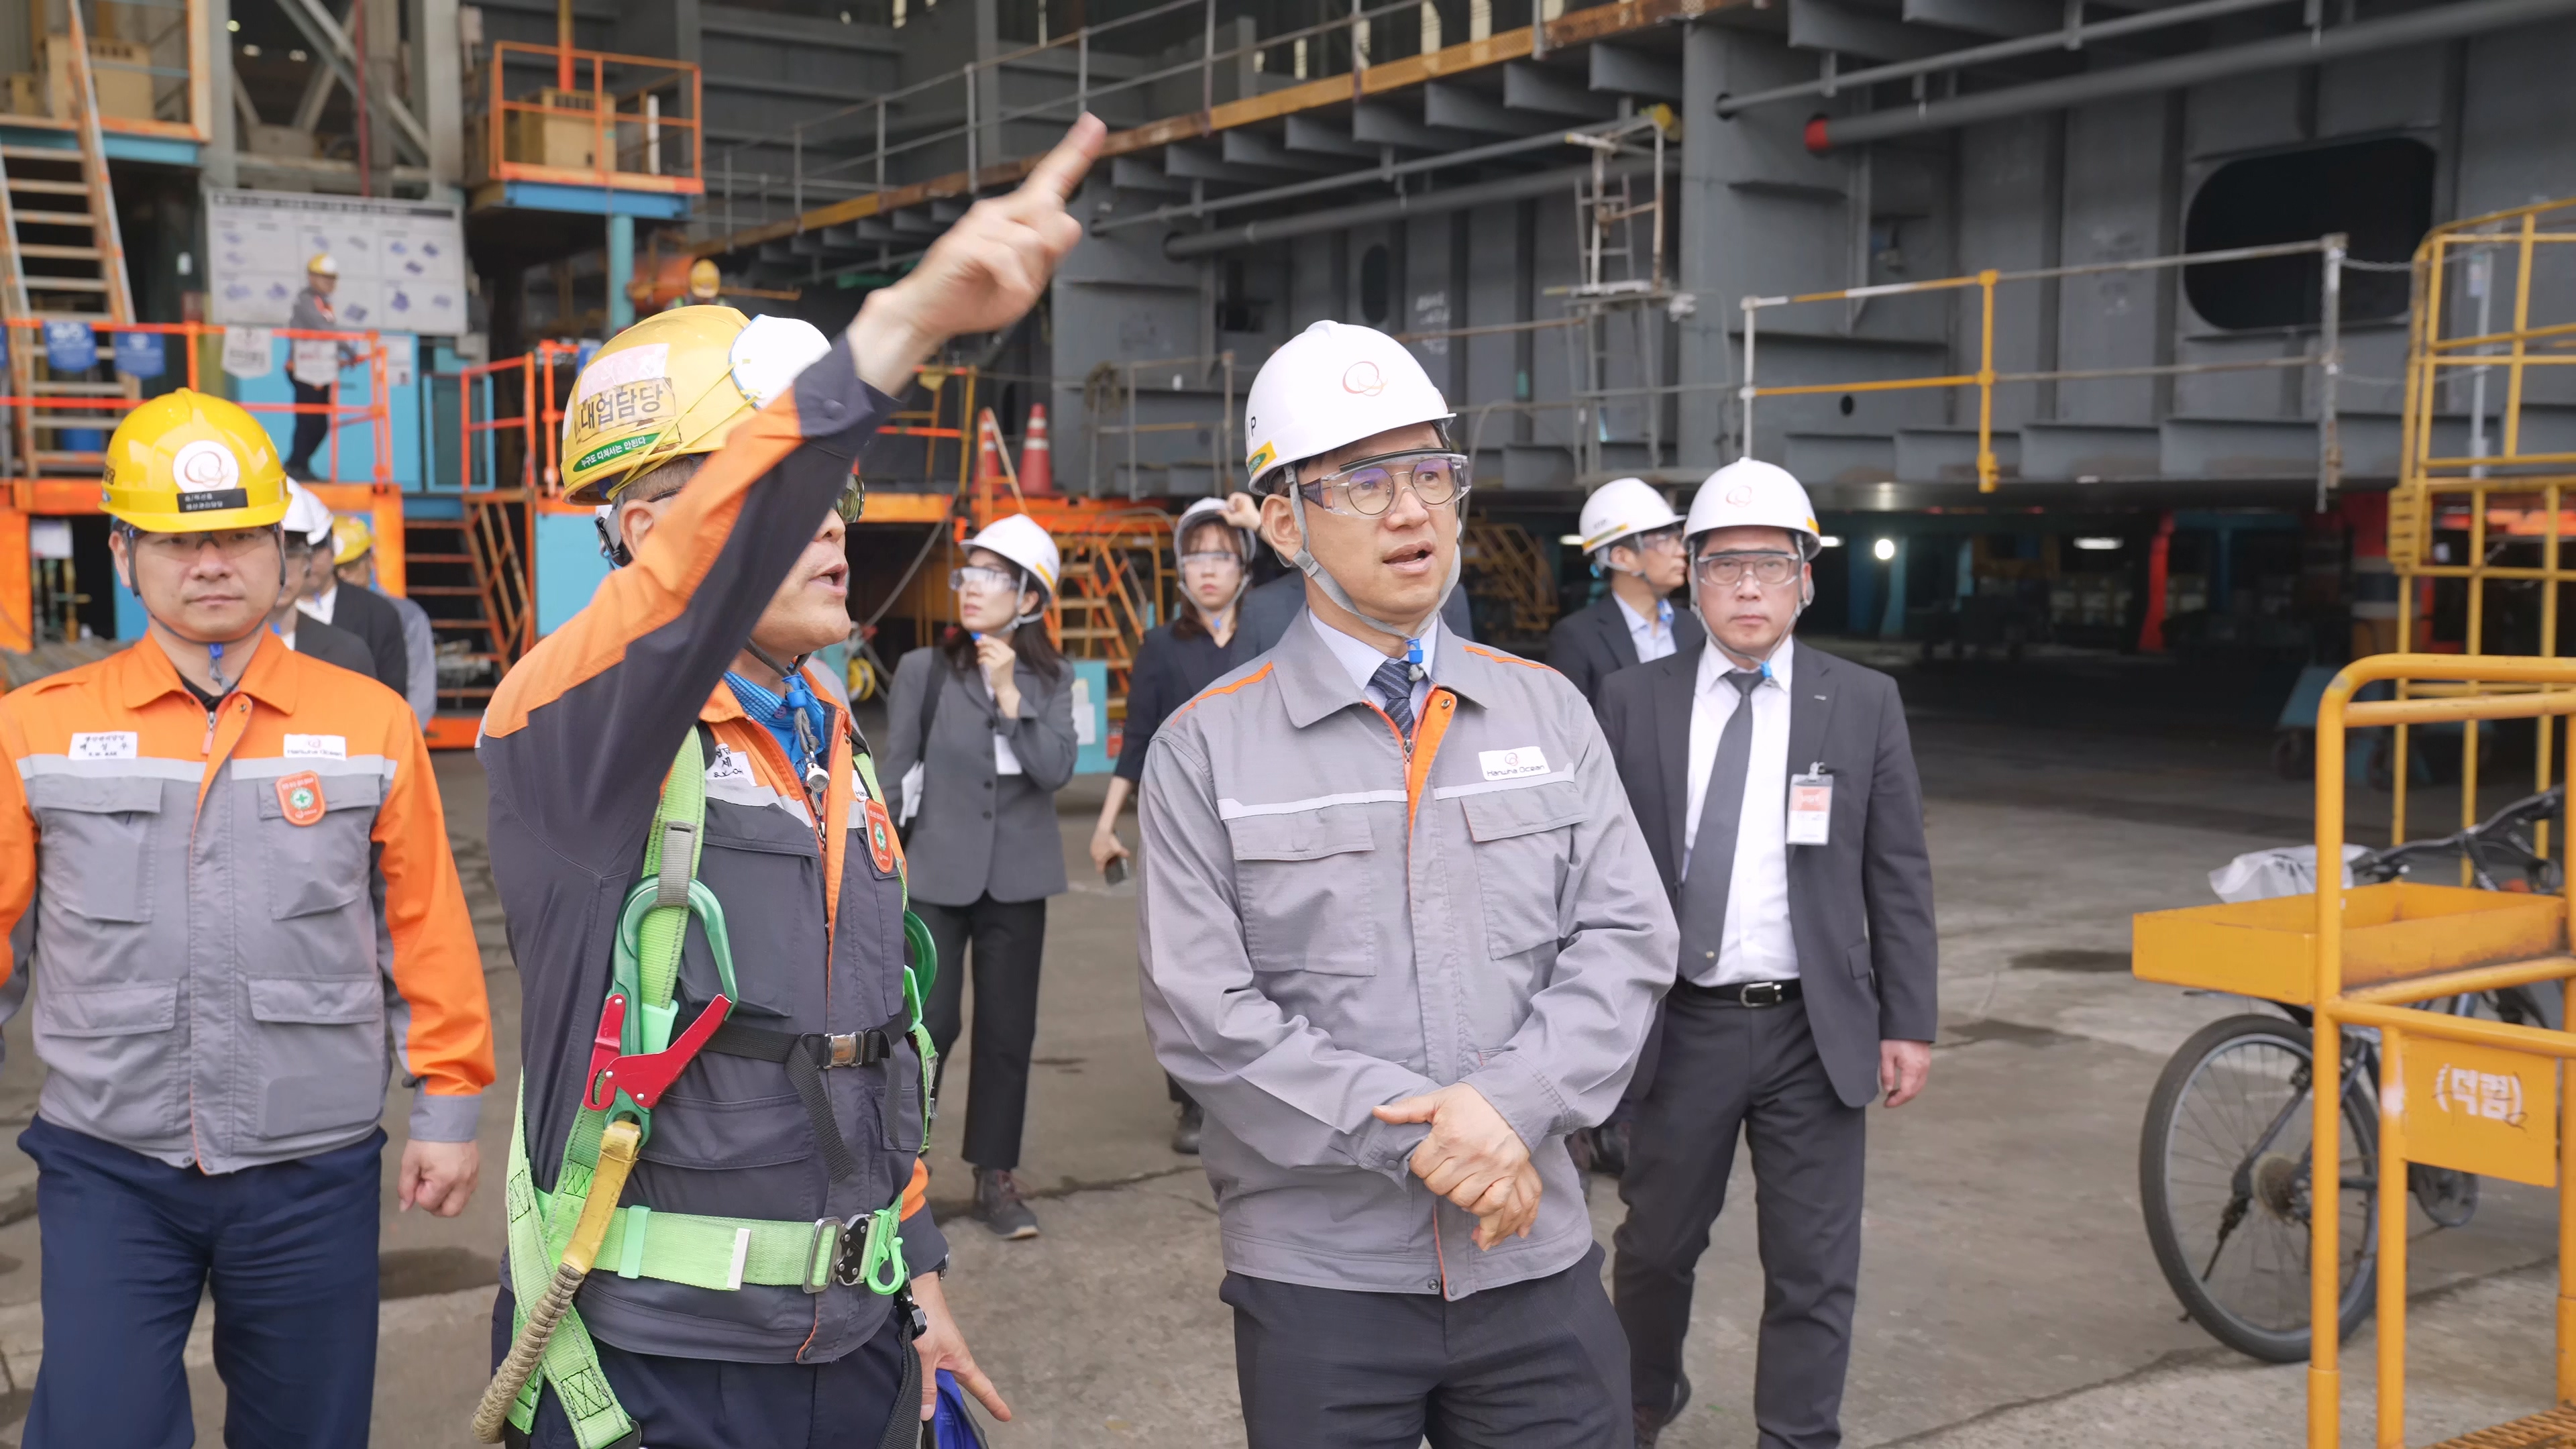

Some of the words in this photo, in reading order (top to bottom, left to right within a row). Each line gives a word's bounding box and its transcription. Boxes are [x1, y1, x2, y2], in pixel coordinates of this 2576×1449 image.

[581, 454, 597, 468] 누구도
[623, 436, 646, 450] 안된다
[1519, 765, 1545, 773] Ocean
